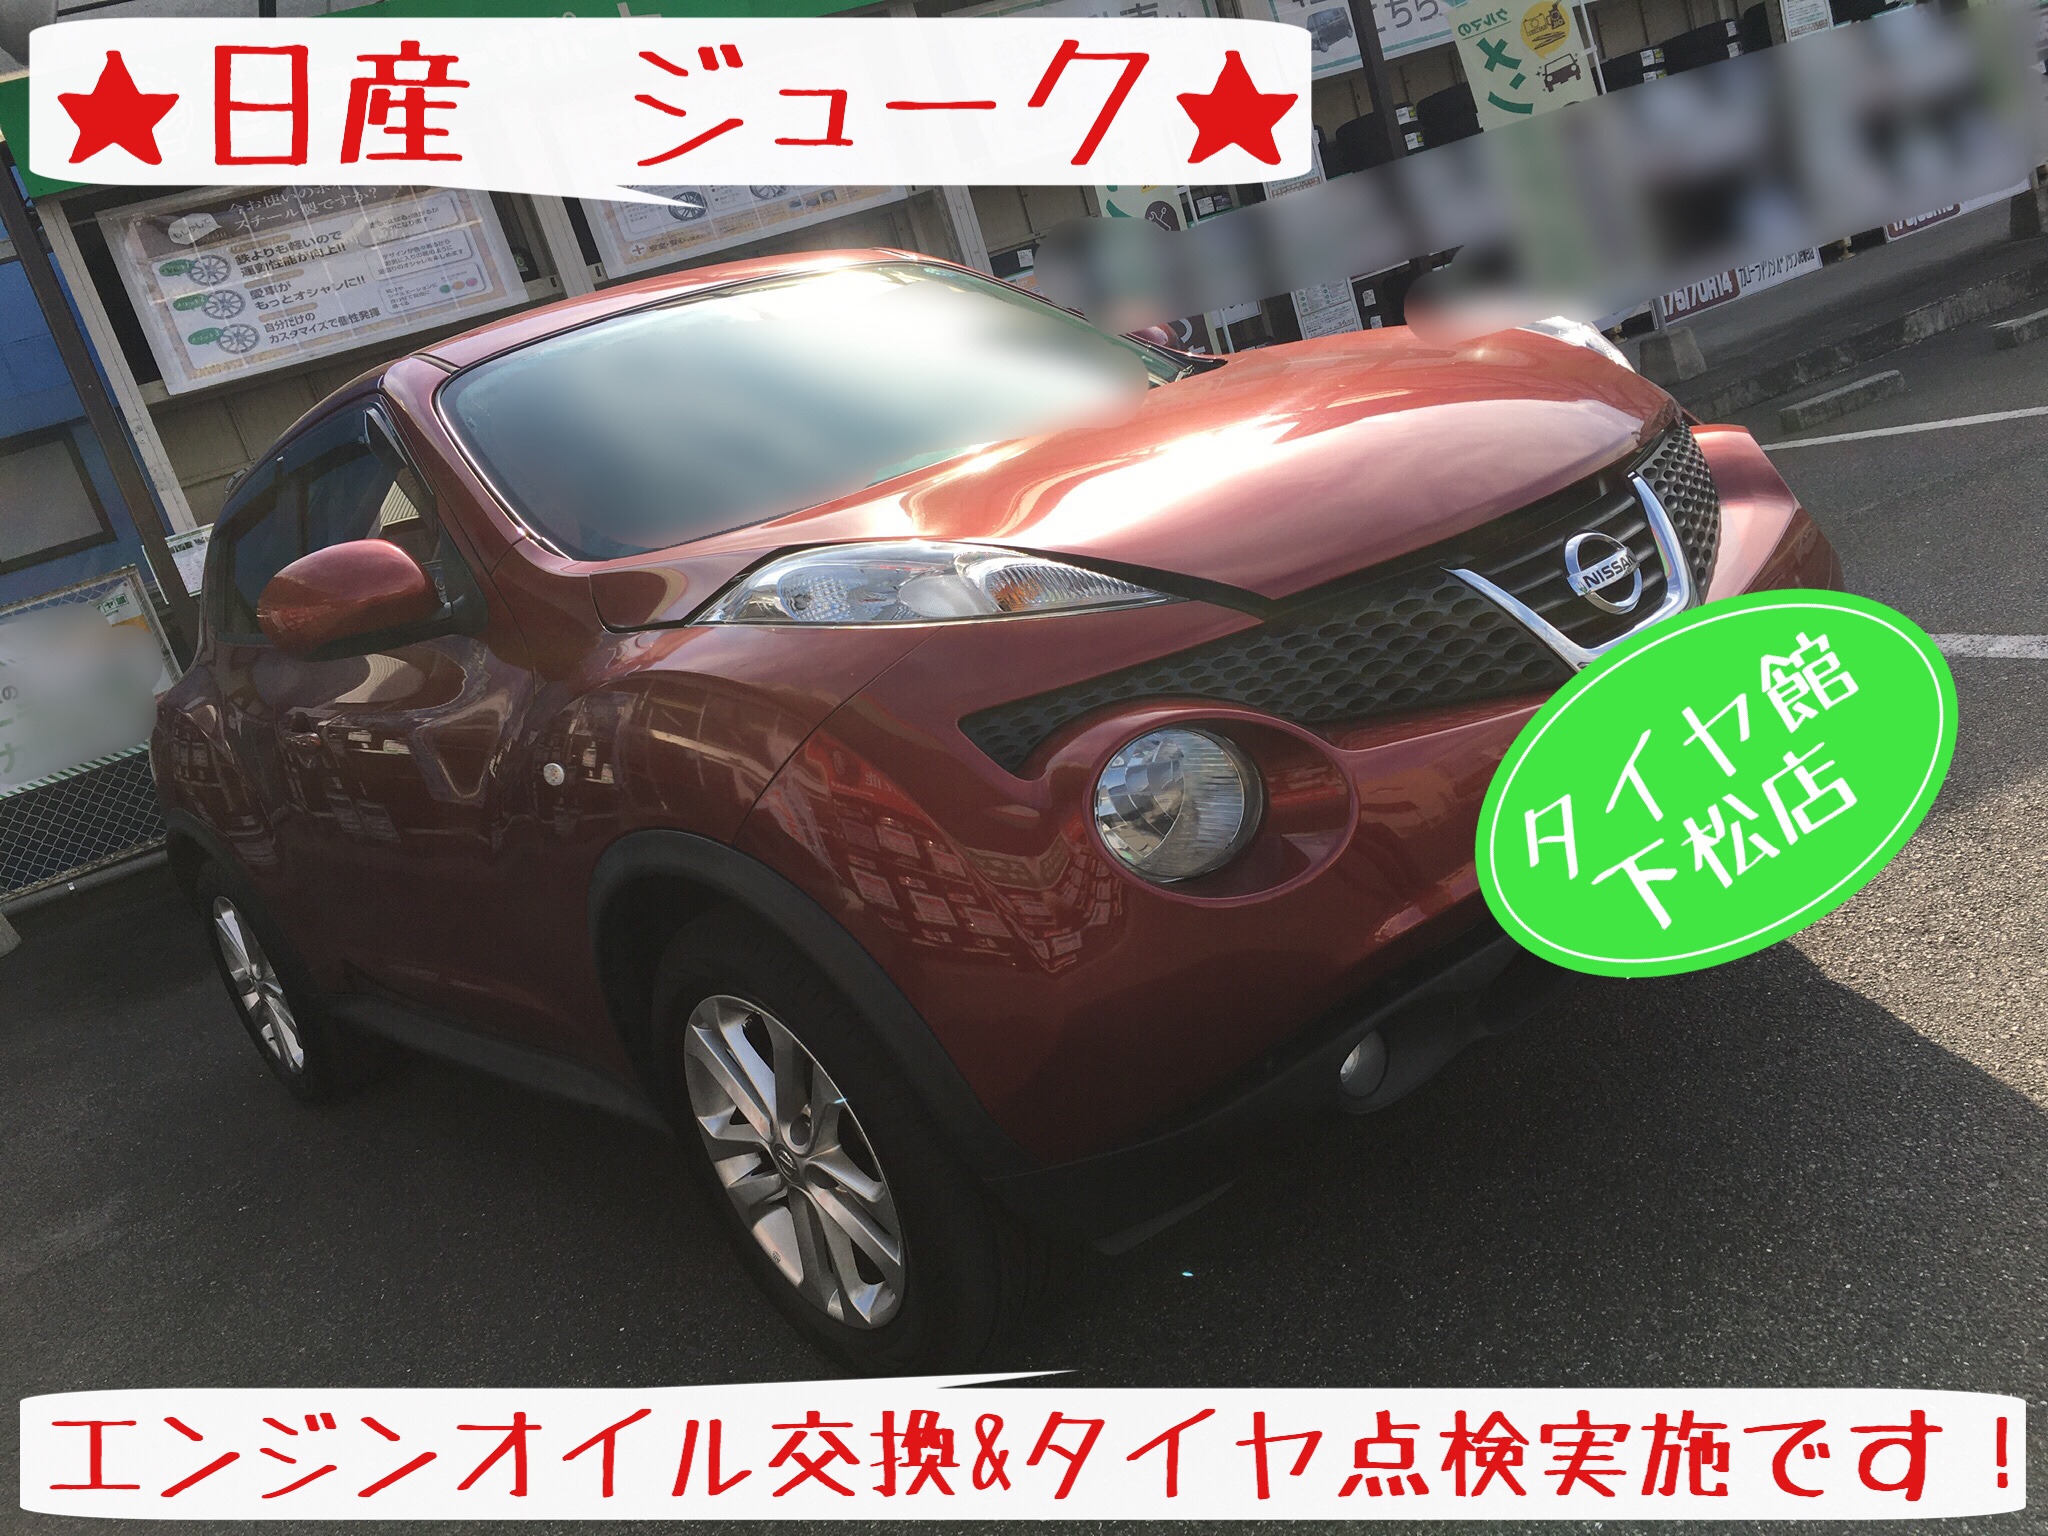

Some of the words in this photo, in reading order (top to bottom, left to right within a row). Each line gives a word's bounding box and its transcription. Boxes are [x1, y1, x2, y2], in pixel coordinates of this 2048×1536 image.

[172, 217, 212, 240] もしかして
[235, 230, 342, 265] 鉄よりも軽いので
[240, 243, 347, 277] 運動性能が向上!!
[249, 281, 292, 300] 愛車が
[254, 275, 366, 311] もっとオシャレに!!
[264, 312, 316, 333] 自分だけの
[269, 307, 381, 344] カスタマイズで個性発揮
[1582, 555, 1634, 589] NISSAN
